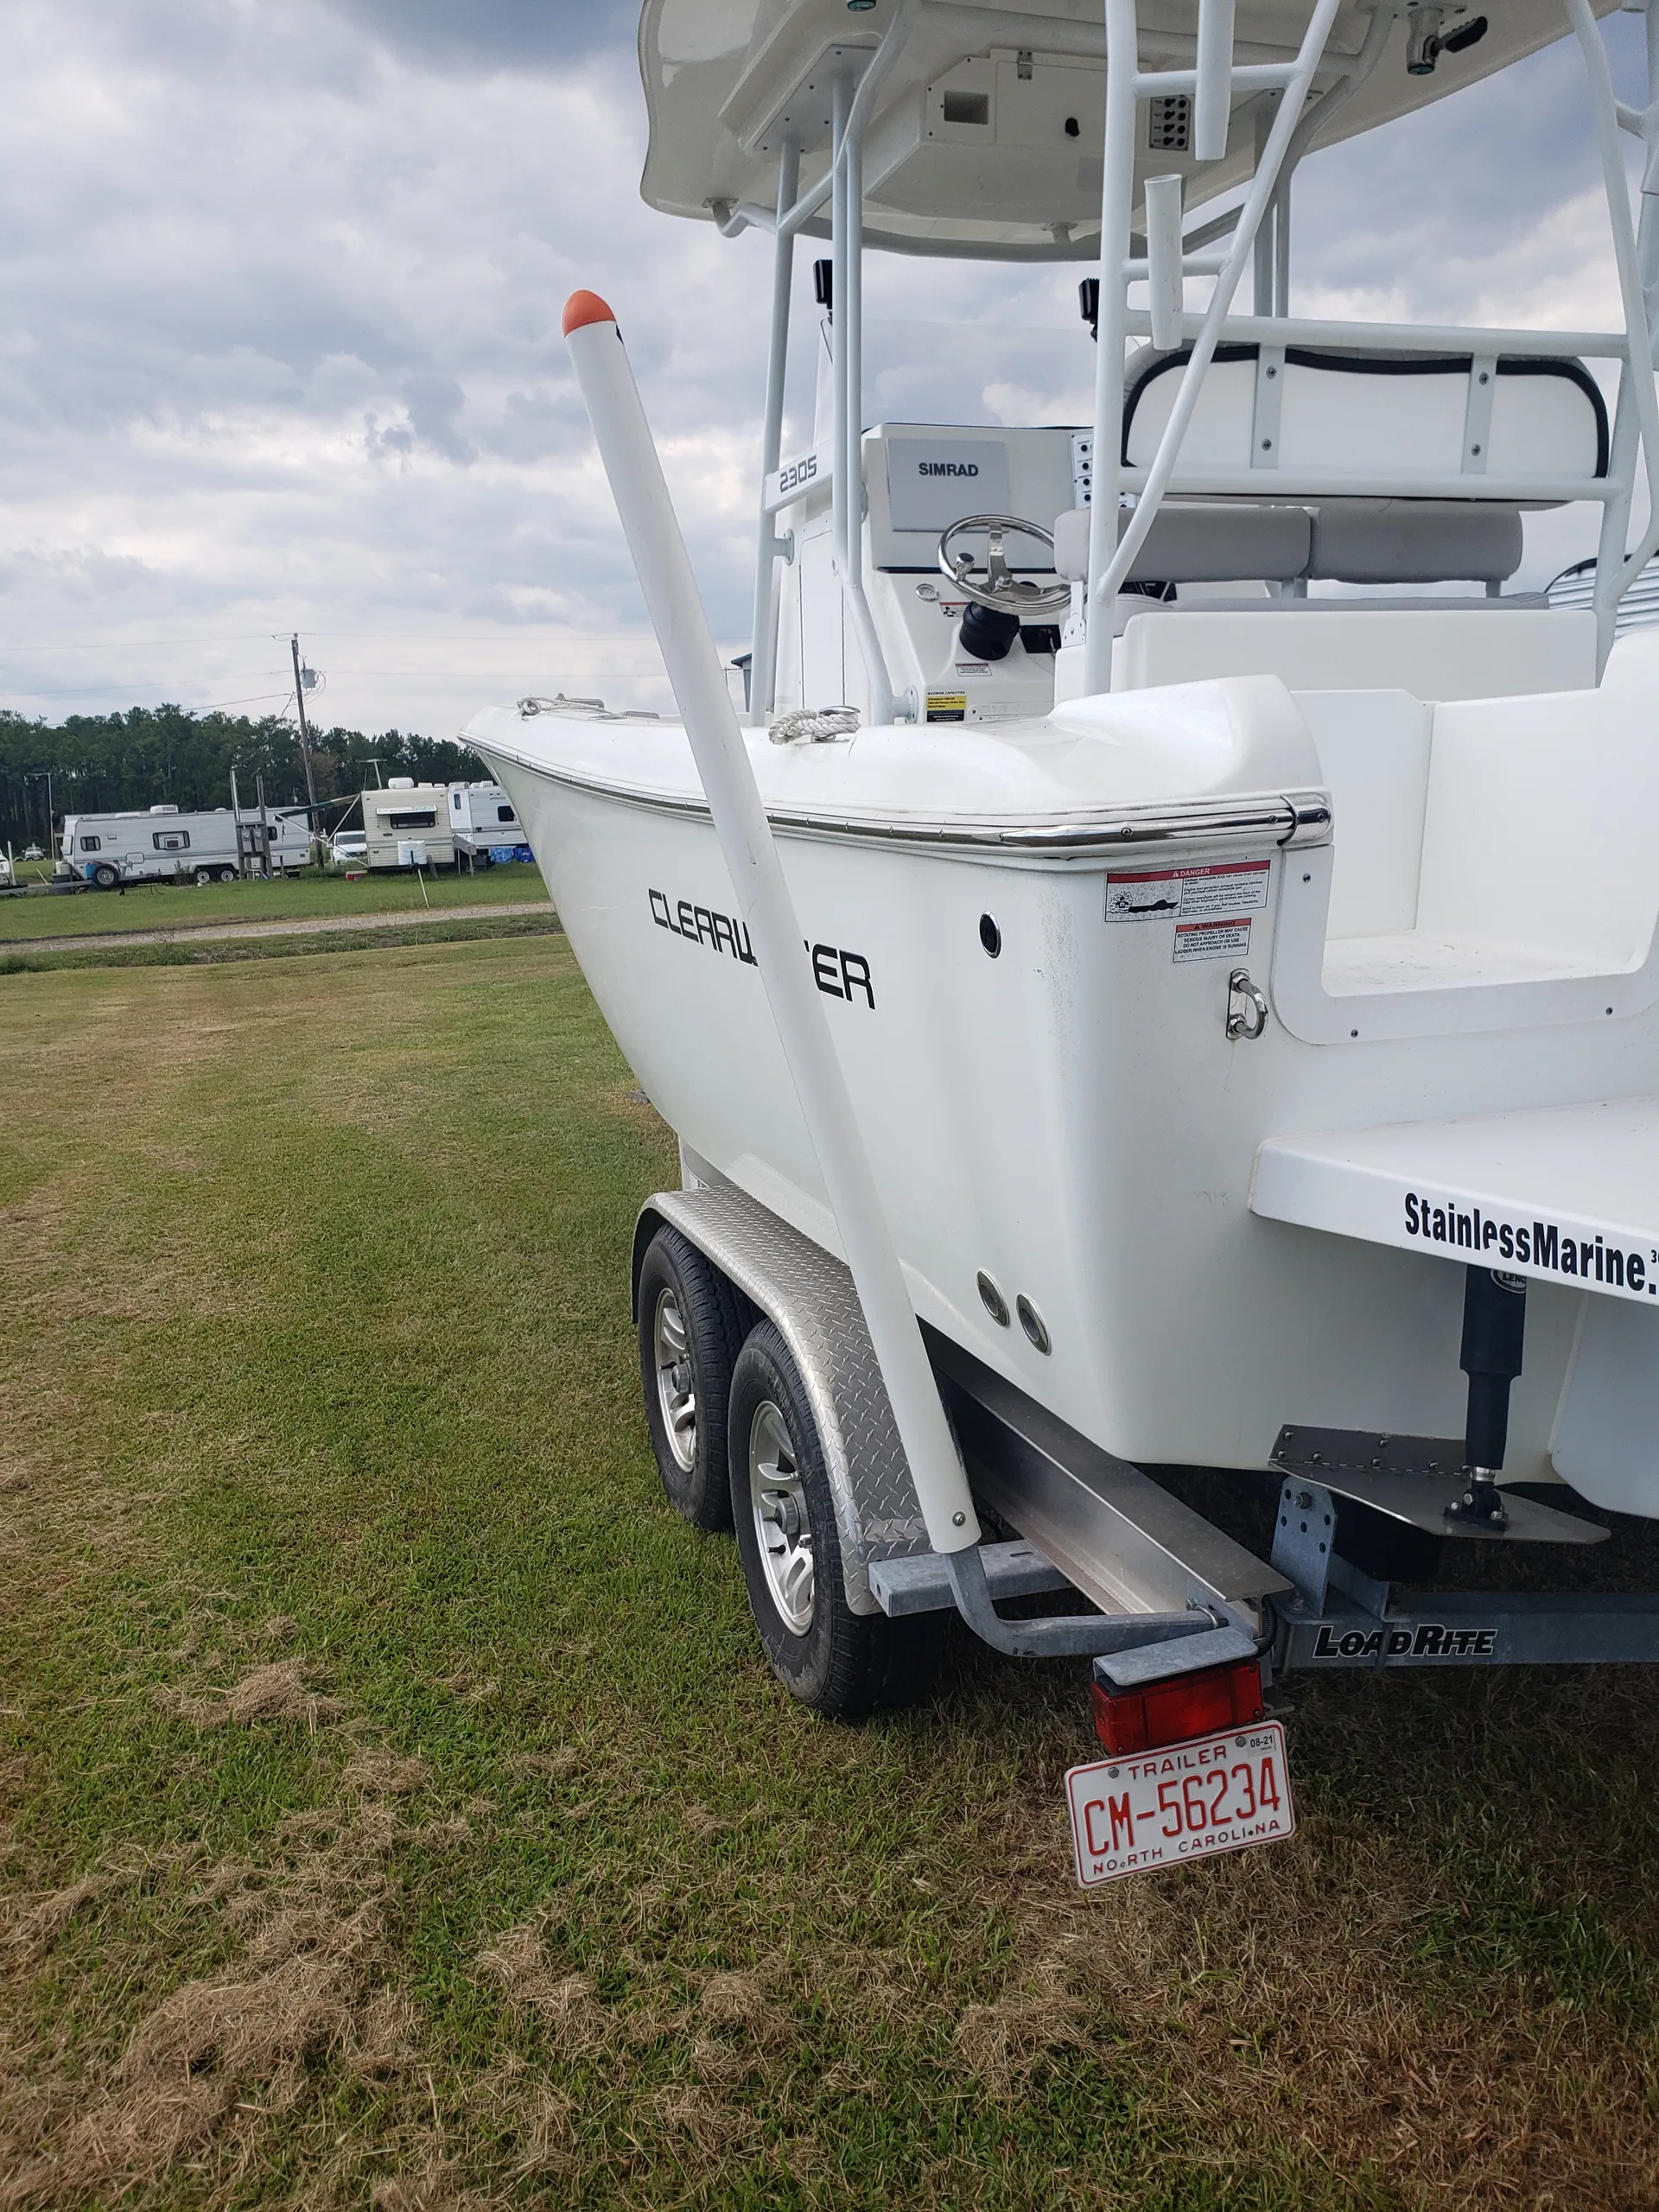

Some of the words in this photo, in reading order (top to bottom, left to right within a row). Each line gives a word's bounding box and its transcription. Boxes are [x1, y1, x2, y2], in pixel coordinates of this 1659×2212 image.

[779, 454, 817, 493] 2305
[918, 462, 979, 477] SIMRAD
[1180, 868, 1210, 877] DANGER
[648, 888, 875, 1010] CLEARWER
[1128, 1745, 1227, 1780] TRAILER
[1250, 1735, 1273, 1747] 08-21
[1084, 1757, 1281, 1857] CM-56234
[1093, 1847, 1163, 1875] NORTH
[1178, 1819, 1281, 1853] CAROLINA
